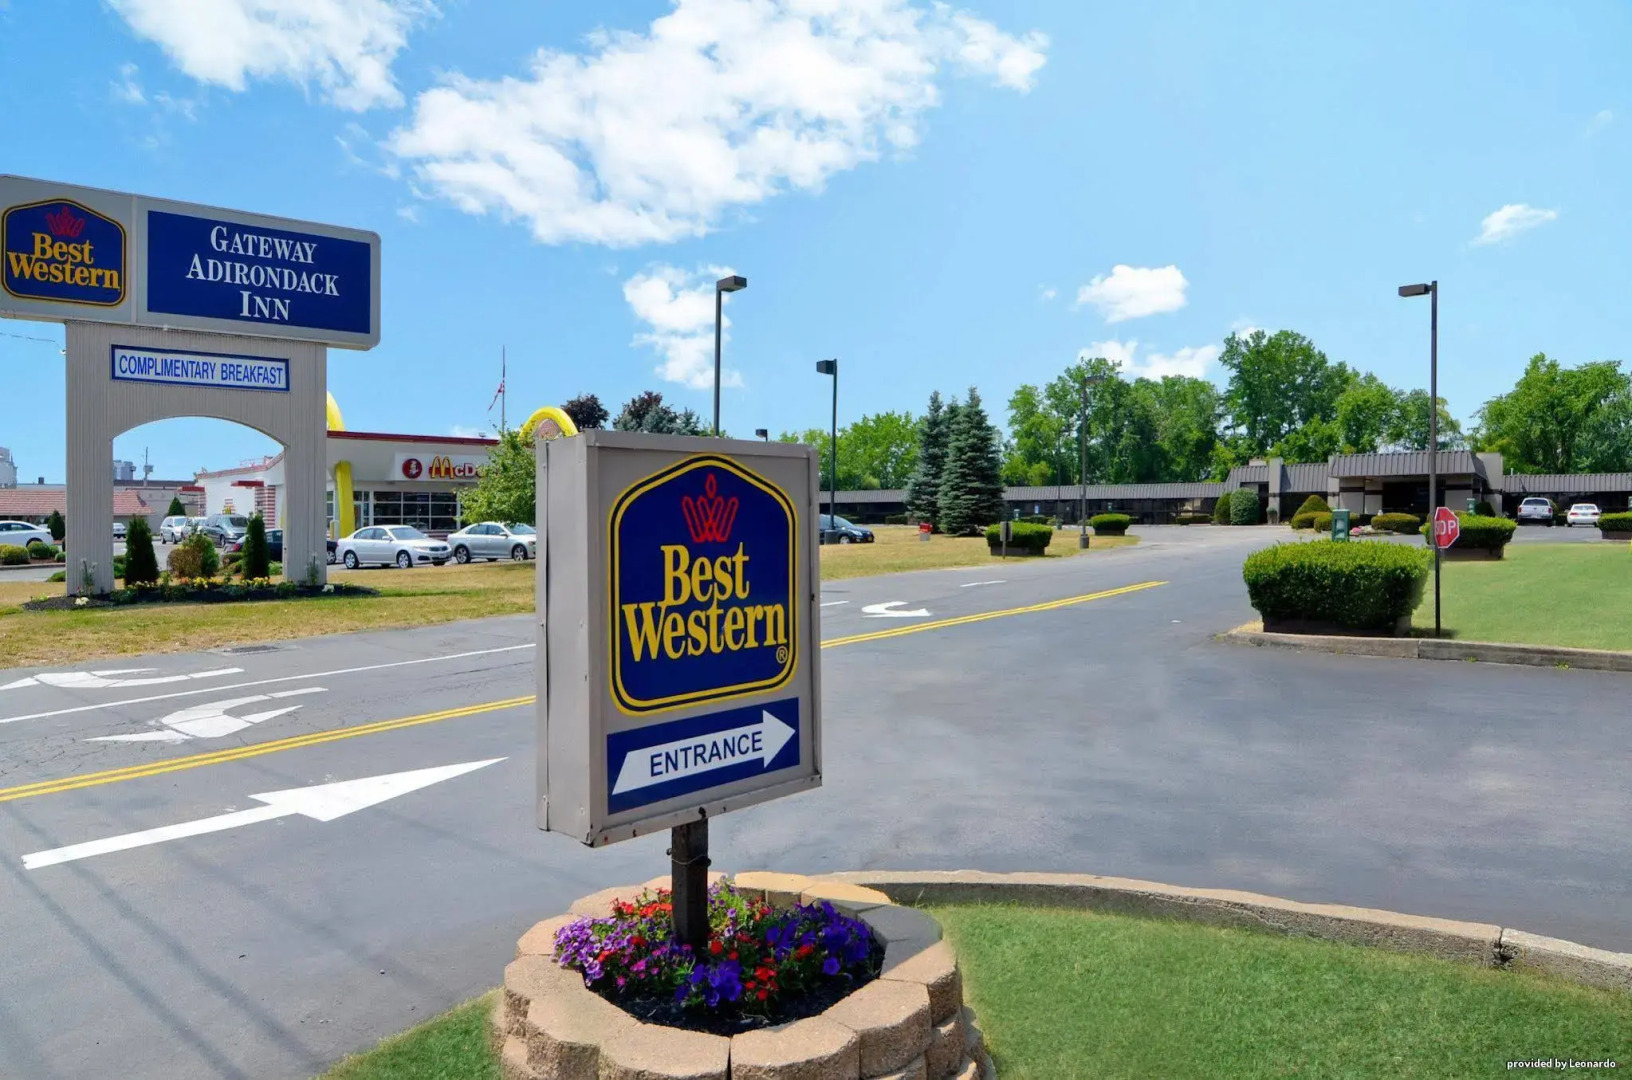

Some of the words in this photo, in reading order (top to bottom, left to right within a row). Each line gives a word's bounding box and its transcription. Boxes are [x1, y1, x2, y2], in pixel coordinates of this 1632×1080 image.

[32, 232, 94, 265] Best
[210, 225, 318, 264] GATEWAY
[7, 251, 120, 290] Western
[185, 253, 340, 297] ADIRONDACK
[239, 290, 291, 321] INN
[119, 354, 217, 380] COMPLIMENTARY
[220, 363, 284, 385] BREAKFAST
[660, 541, 750, 607] Best
[621, 600, 788, 662] Western
[650, 730, 763, 777] ENTRANCE
